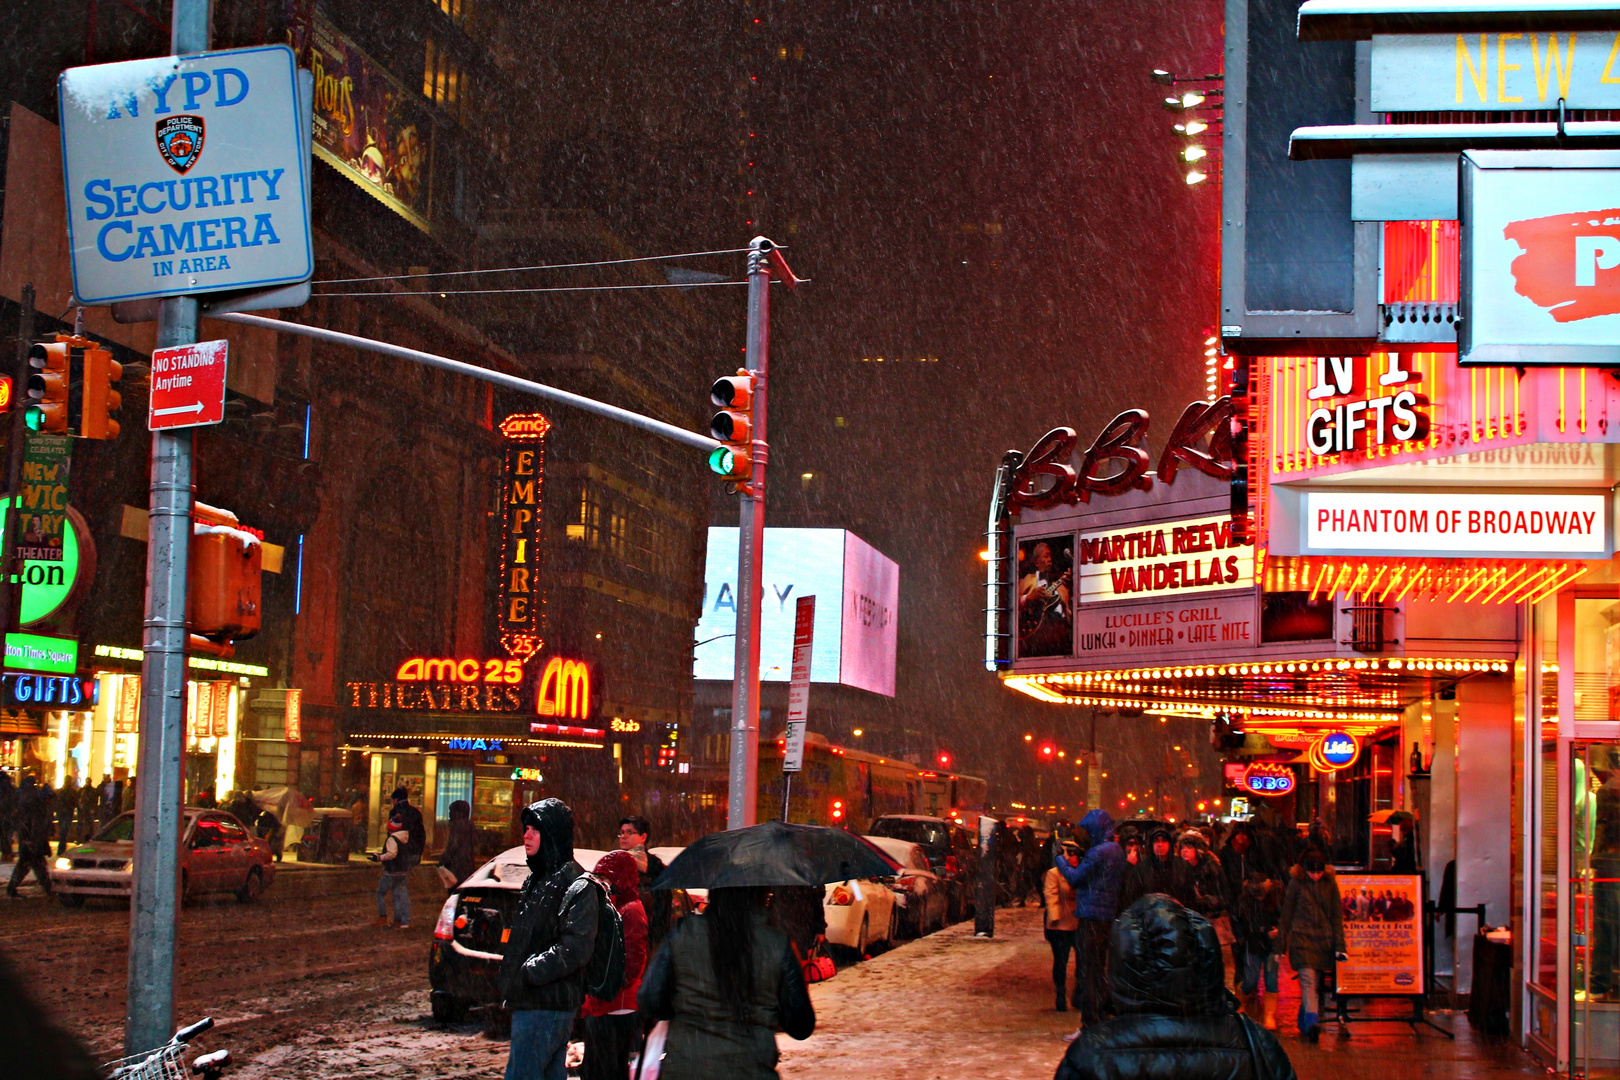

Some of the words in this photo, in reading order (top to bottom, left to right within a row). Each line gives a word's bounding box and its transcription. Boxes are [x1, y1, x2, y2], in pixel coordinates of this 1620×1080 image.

[1455, 31, 1577, 104] NEW
[158, 124, 203, 138] DEPARTMENT
[167, 117, 193, 126] POLICE
[159, 142, 170, 157] CITY
[194, 136, 203, 153] YORK
[84, 168, 285, 221] SECURITY
[97, 213, 280, 262] CAMERA
[153, 261, 174, 277] IN
[178, 255, 231, 274] AREA
[156, 357, 169, 373] NO
[171, 350, 215, 371] STANDING
[155, 374, 193, 392] Anytime
[1306, 391, 1417, 456] GIFTS
[23, 462, 58, 481] NEW
[26, 485, 67, 510] VIC
[1318, 509, 1427, 533] PHANTOM
[1436, 510, 1462, 533] OF
[1469, 511, 1596, 535] BROADWAY
[508, 450, 536, 622] EMPIRE
[17, 546, 62, 560] THEATER
[1081, 530, 1166, 565] MARTHA
[1110, 556, 1238, 594] VANDELLAS
[1105, 611, 1175, 629] LUCILLE'S
[1178, 607, 1222, 622] GRILL
[512, 638, 534, 654] 25
[1081, 632, 1116, 650] LUNCH
[1129, 628, 1174, 648] DINNER
[1187, 625, 1216, 643] LATE
[1222, 622, 1250, 640] NITE
[23, 645, 46, 660] Times
[46, 648, 73, 664] Square
[484, 659, 524, 683] 25
[15, 675, 82, 705] GIFTS
[347, 682, 521, 712] THEATRES
[448, 739, 503, 751] IMAX
[1323, 741, 1355, 755] Lids
[1248, 776, 1292, 790] BBQ
[1345, 930, 1384, 939] CLASSIC
[1386, 930, 1411, 939] SOUL
